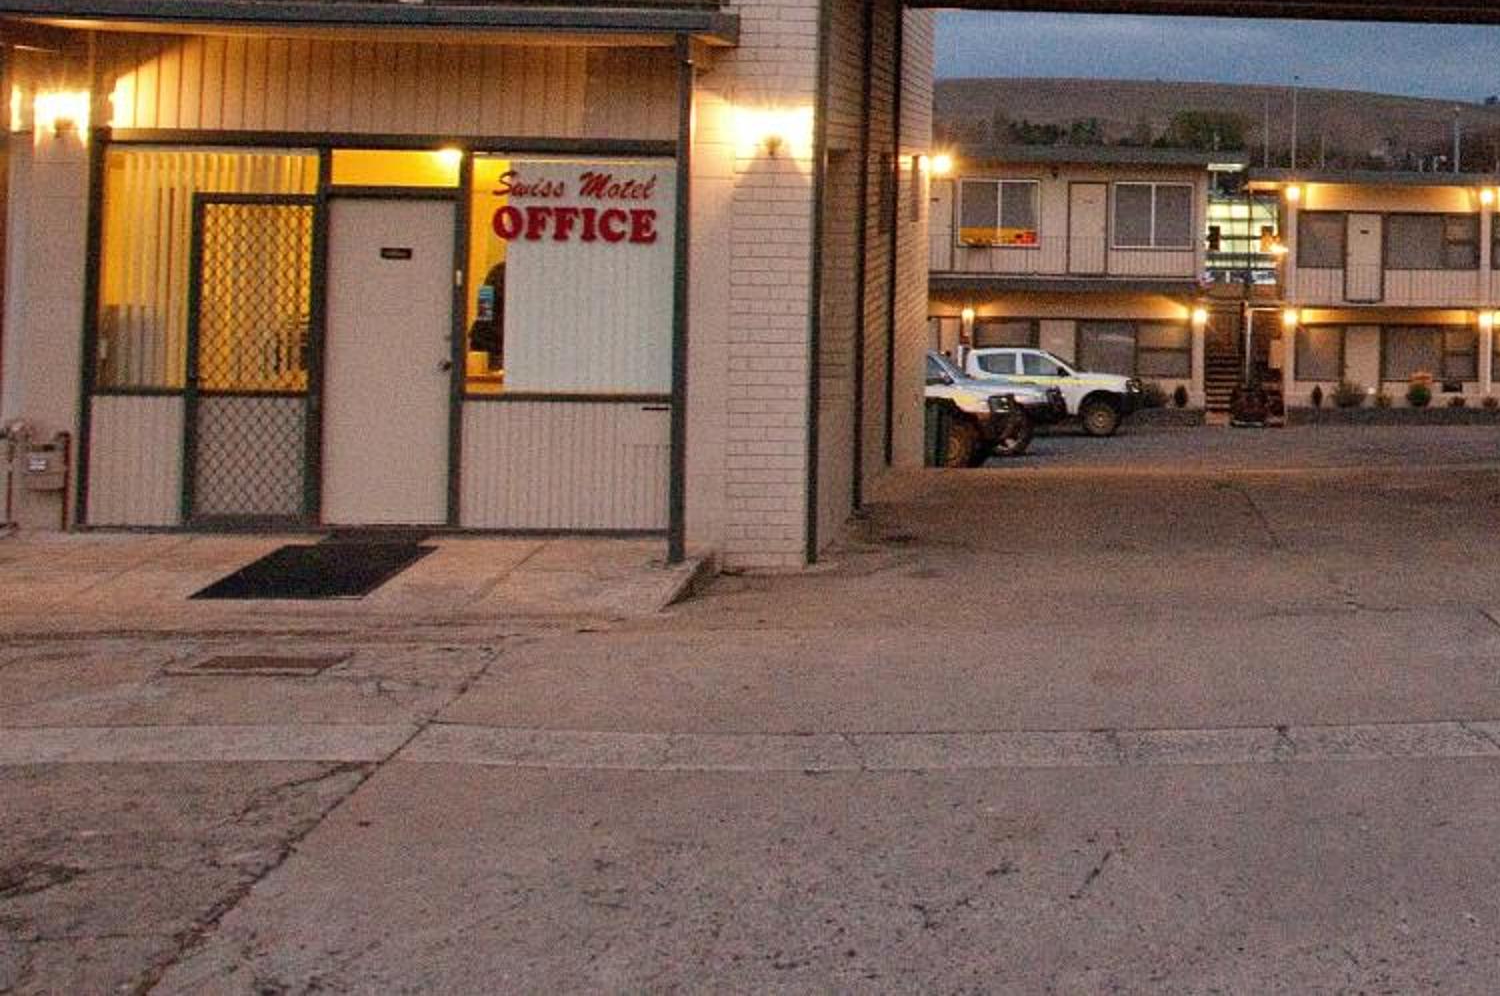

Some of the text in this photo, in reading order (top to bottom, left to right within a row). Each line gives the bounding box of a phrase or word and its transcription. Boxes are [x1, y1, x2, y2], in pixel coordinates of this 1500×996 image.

[492, 170, 657, 200] Swiss Motel
[492, 205, 657, 244] OFFICE
